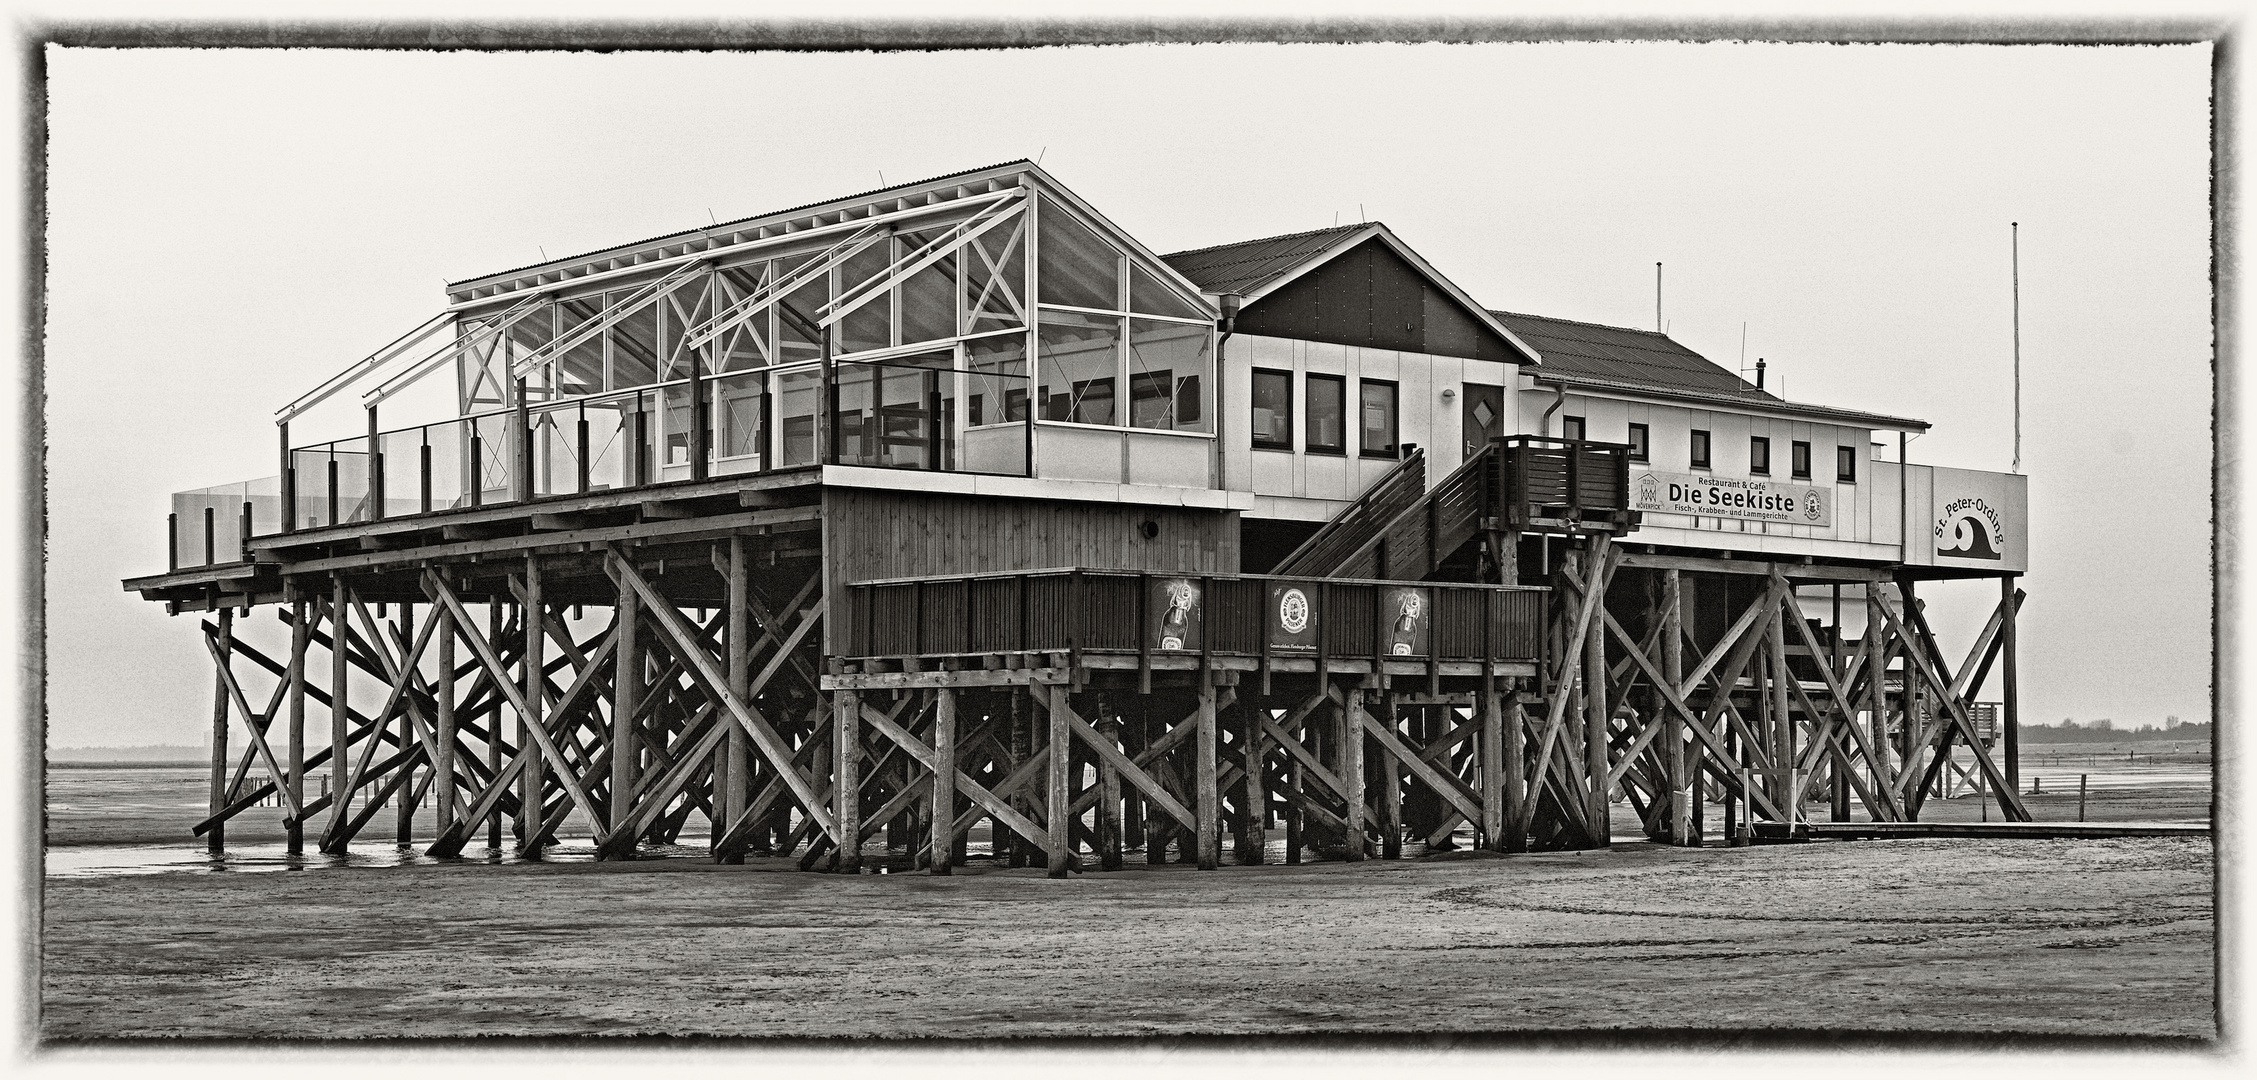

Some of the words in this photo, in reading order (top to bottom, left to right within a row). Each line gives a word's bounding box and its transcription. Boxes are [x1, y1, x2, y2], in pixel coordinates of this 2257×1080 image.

[1698, 477, 1740, 488] Restaurant
[1750, 482, 1766, 490] Café
[1669, 484, 1702, 502] Die
[1708, 487, 1794, 512] Seekiste
[1674, 504, 1696, 512] Fisch-,
[1698, 506, 1728, 515] Krabben-
[1744, 510, 1788, 520] Lammgerichte
[1935, 518, 1947, 538] St.
[1945, 498, 2004, 544] Peter-Ording
